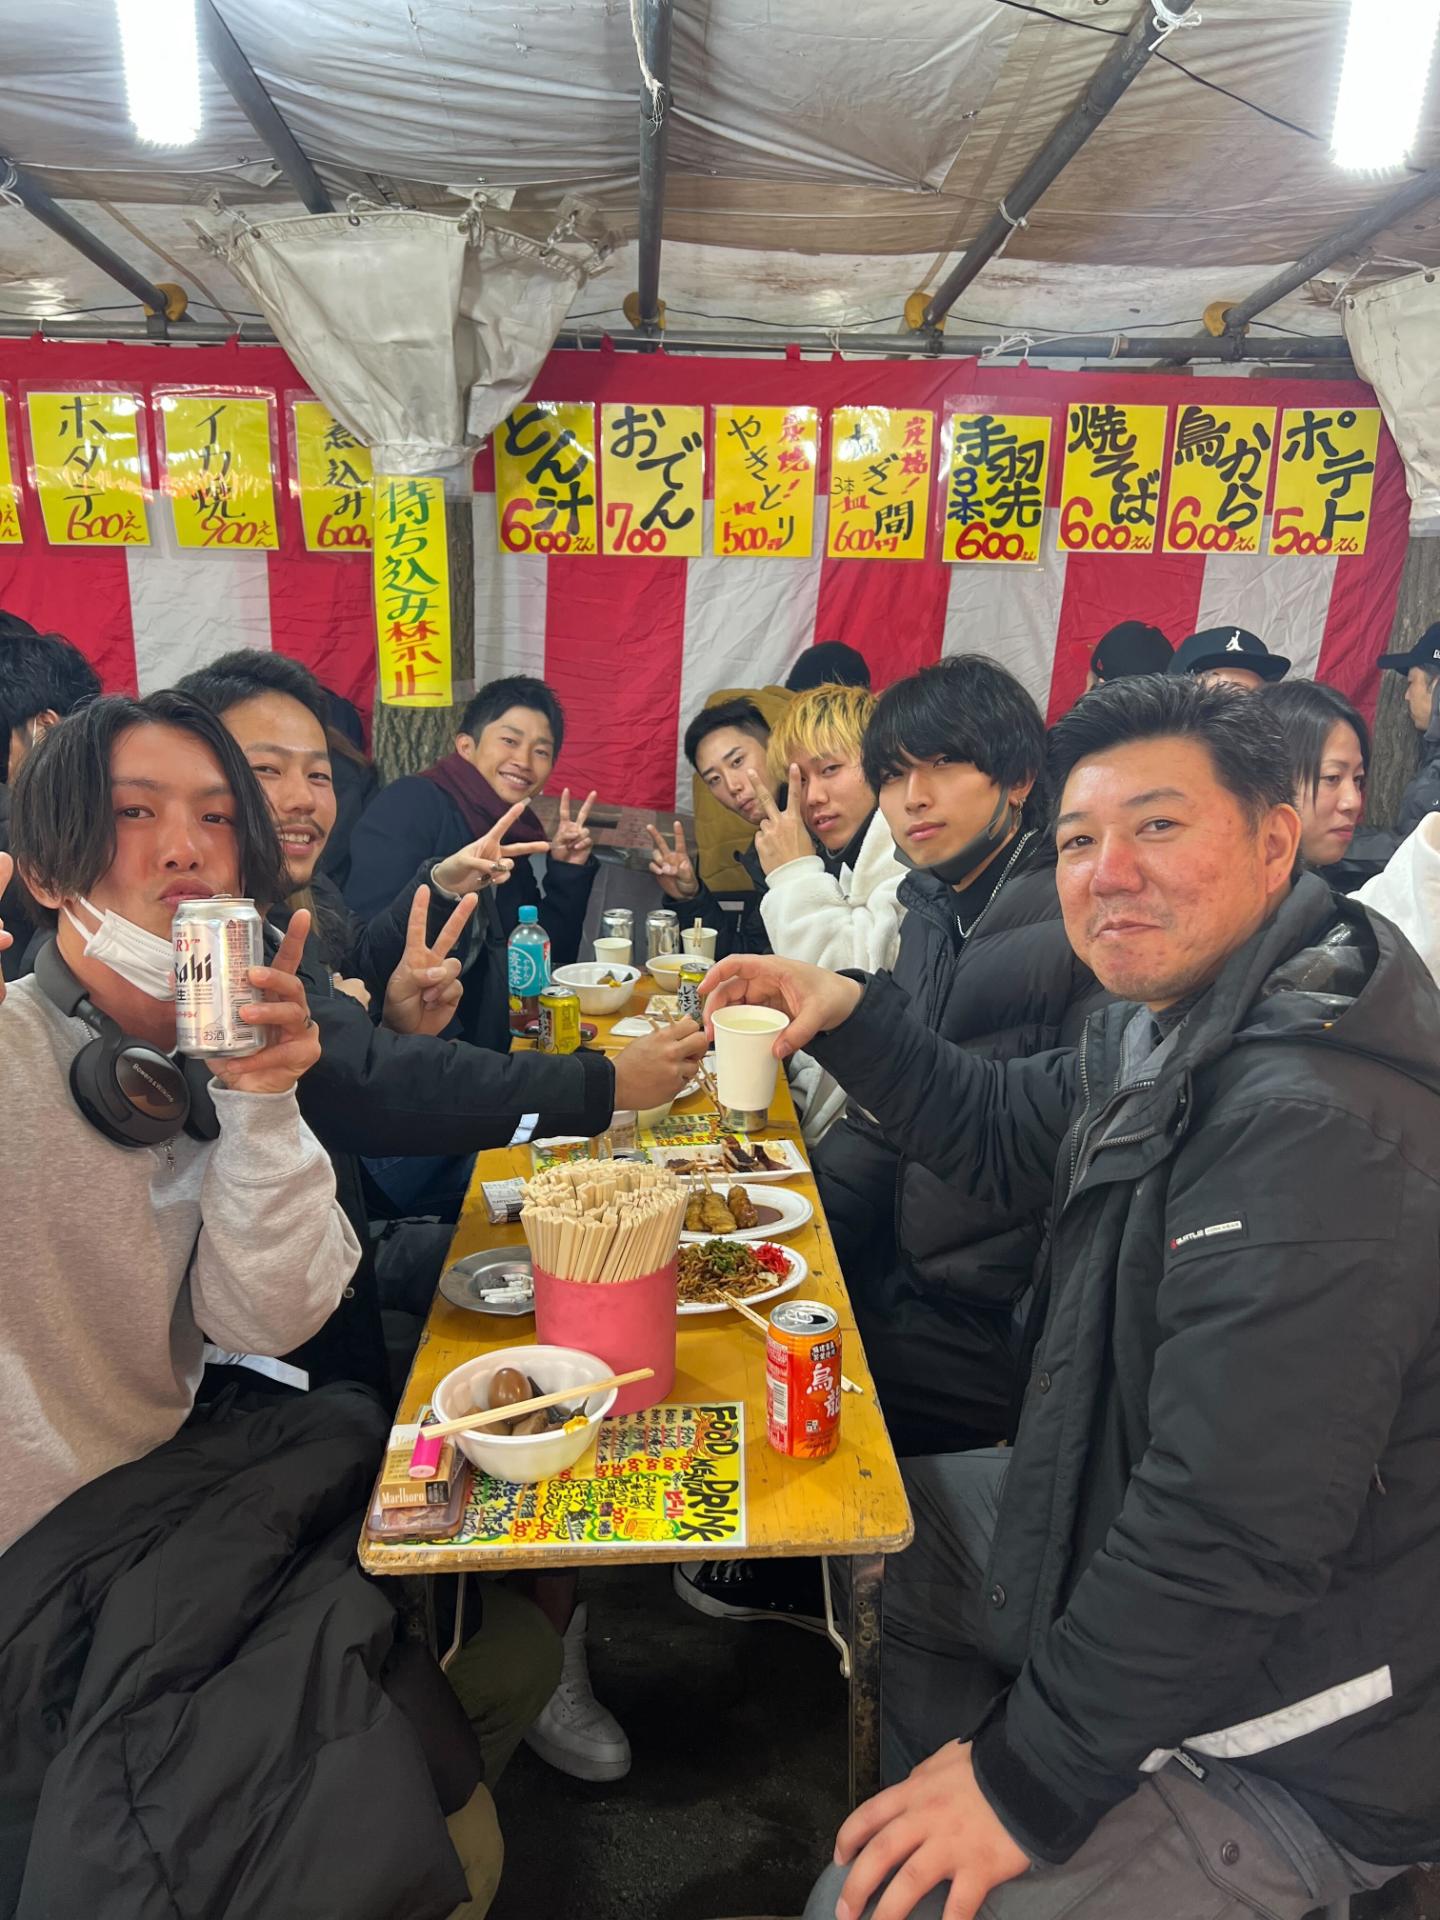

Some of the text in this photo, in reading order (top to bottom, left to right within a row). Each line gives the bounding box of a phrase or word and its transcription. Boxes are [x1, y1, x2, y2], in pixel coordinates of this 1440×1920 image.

[58, 397, 109, 521] ホタテ
[192, 405, 246, 521] イカ焼
[505, 408, 594, 536] とん汁
[610, 406, 703, 531] おでん
[727, 415, 794, 548] やきとり
[830, 476, 855, 496] 3本
[947, 467, 985, 526] 3本
[956, 415, 1045, 529] 手羽先
[1068, 405, 1160, 526] 焼そば
[1174, 405, 1271, 530] 鳥から
[1282, 410, 1375, 539] ポテト
[0, 503, 18, 537] えん
[605, 502, 667, 554] 700
[833, 520, 899, 553] 600円
[379, 481, 443, 699] 持ち込み禁止
[203, 1030, 225, 1041] お酒
[700, 1405, 739, 1456] FOOD
[381, 1487, 424, 1505] Marlboro
[665, 1490, 686, 1519] ビール
[676, 1479, 739, 1542] DRINK
